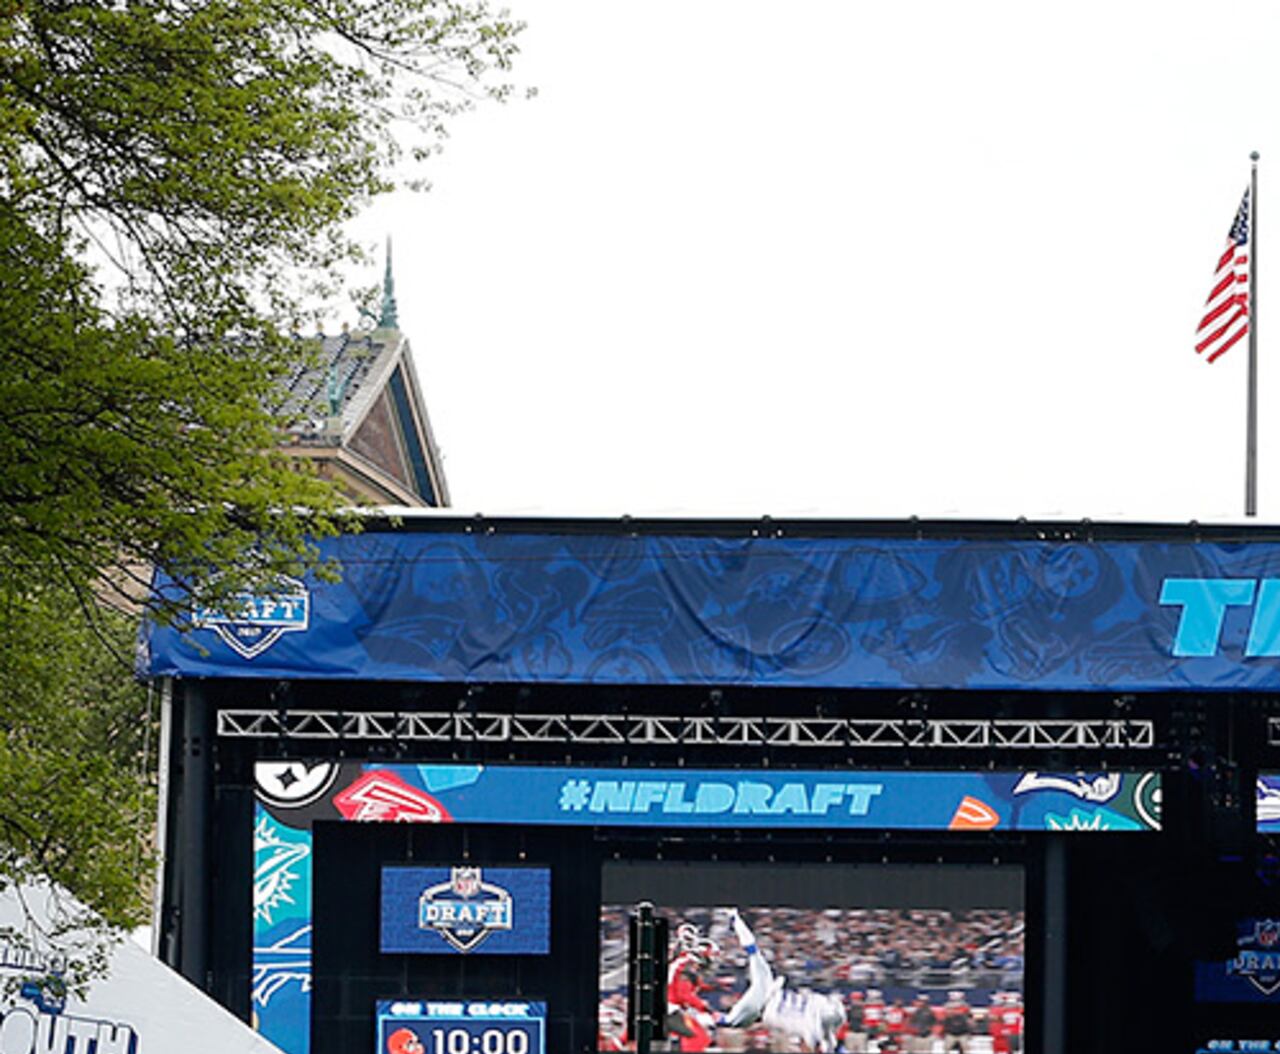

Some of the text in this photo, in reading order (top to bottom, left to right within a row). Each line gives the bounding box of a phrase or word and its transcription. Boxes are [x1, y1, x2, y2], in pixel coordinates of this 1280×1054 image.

[559, 779, 883, 815] #NFLDRAFT
[426, 904, 504, 921] DRAFT
[391, 1003, 530, 1016] ON THE CLOCK
[1238, 1040, 1270, 1051] THE
